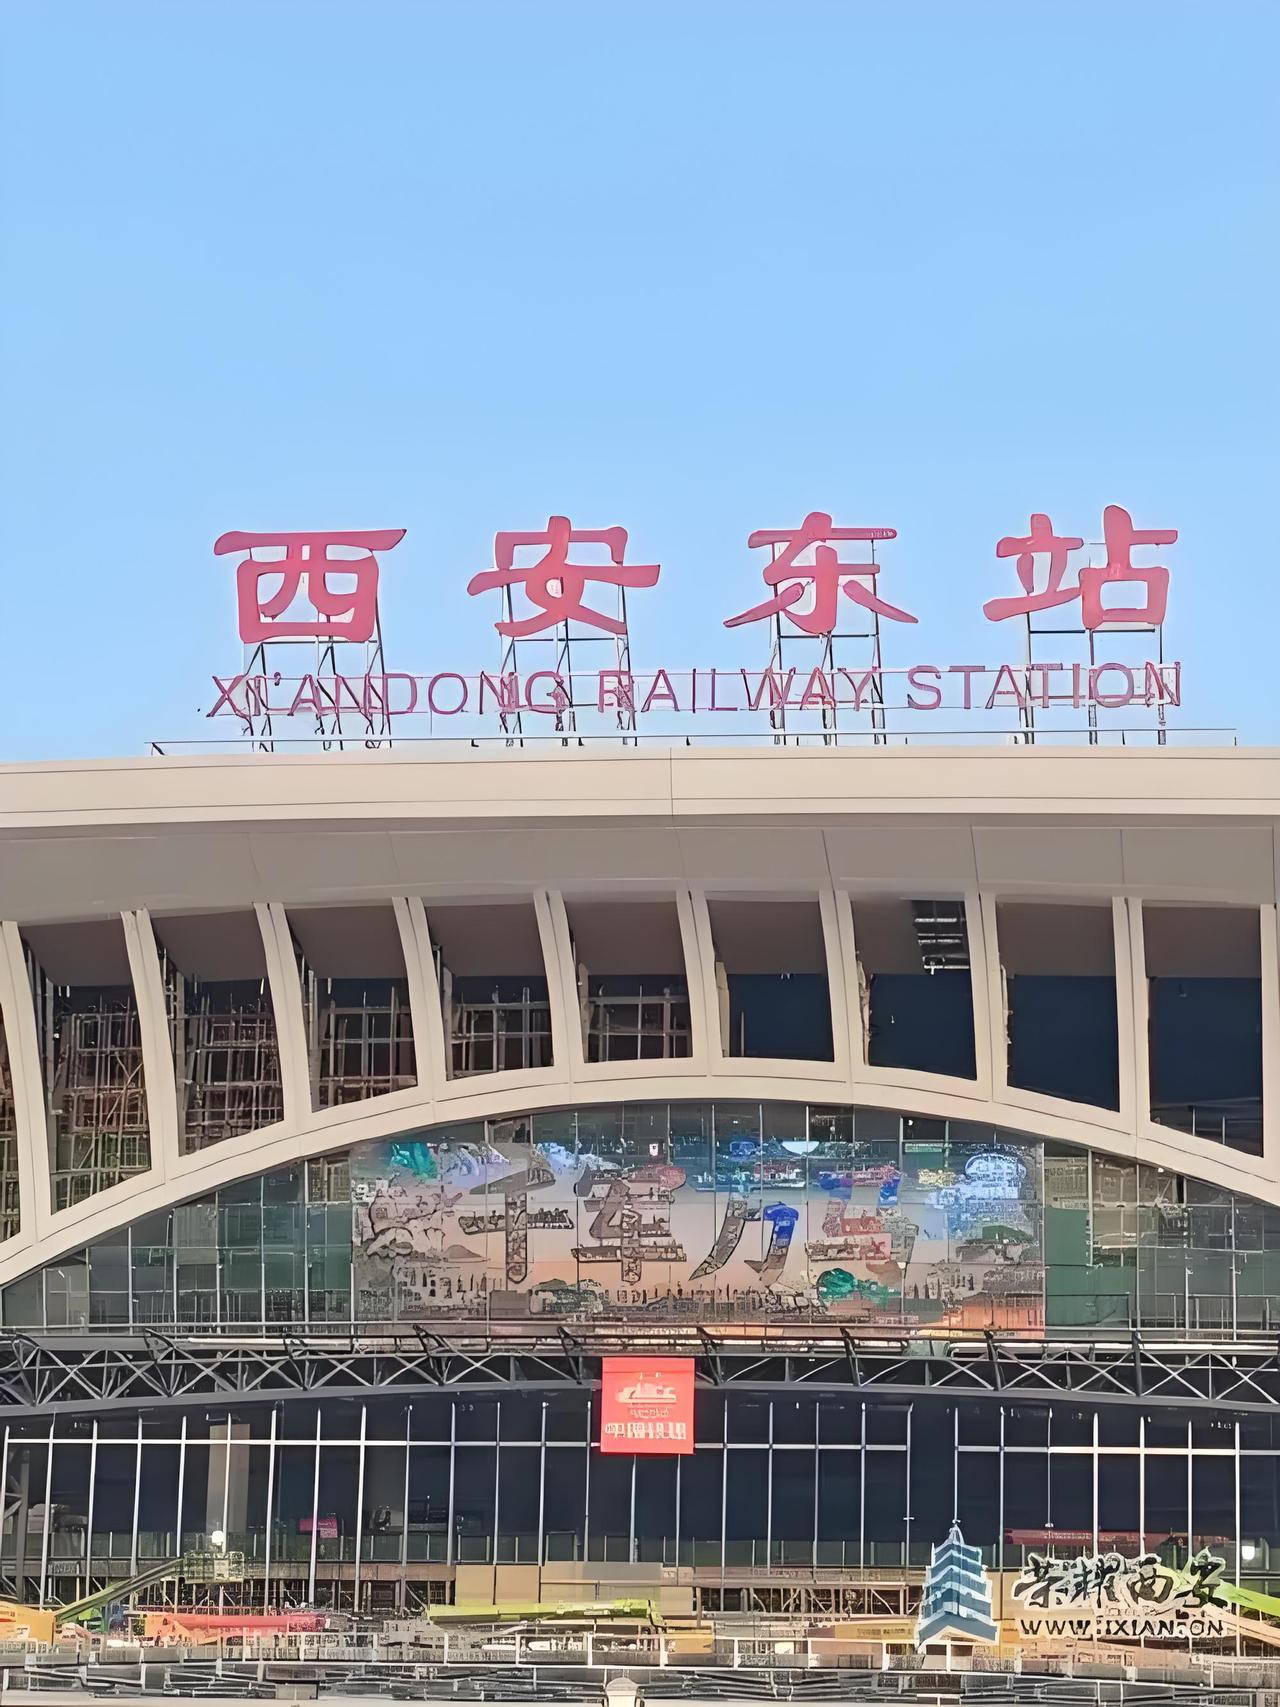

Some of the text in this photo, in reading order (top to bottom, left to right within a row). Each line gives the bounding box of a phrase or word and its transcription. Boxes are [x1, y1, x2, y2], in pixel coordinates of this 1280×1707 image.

[213, 504, 1178, 643] 西安东站
[598, 667, 879, 714] RAILWAY
[906, 663, 1182, 710] STATION
